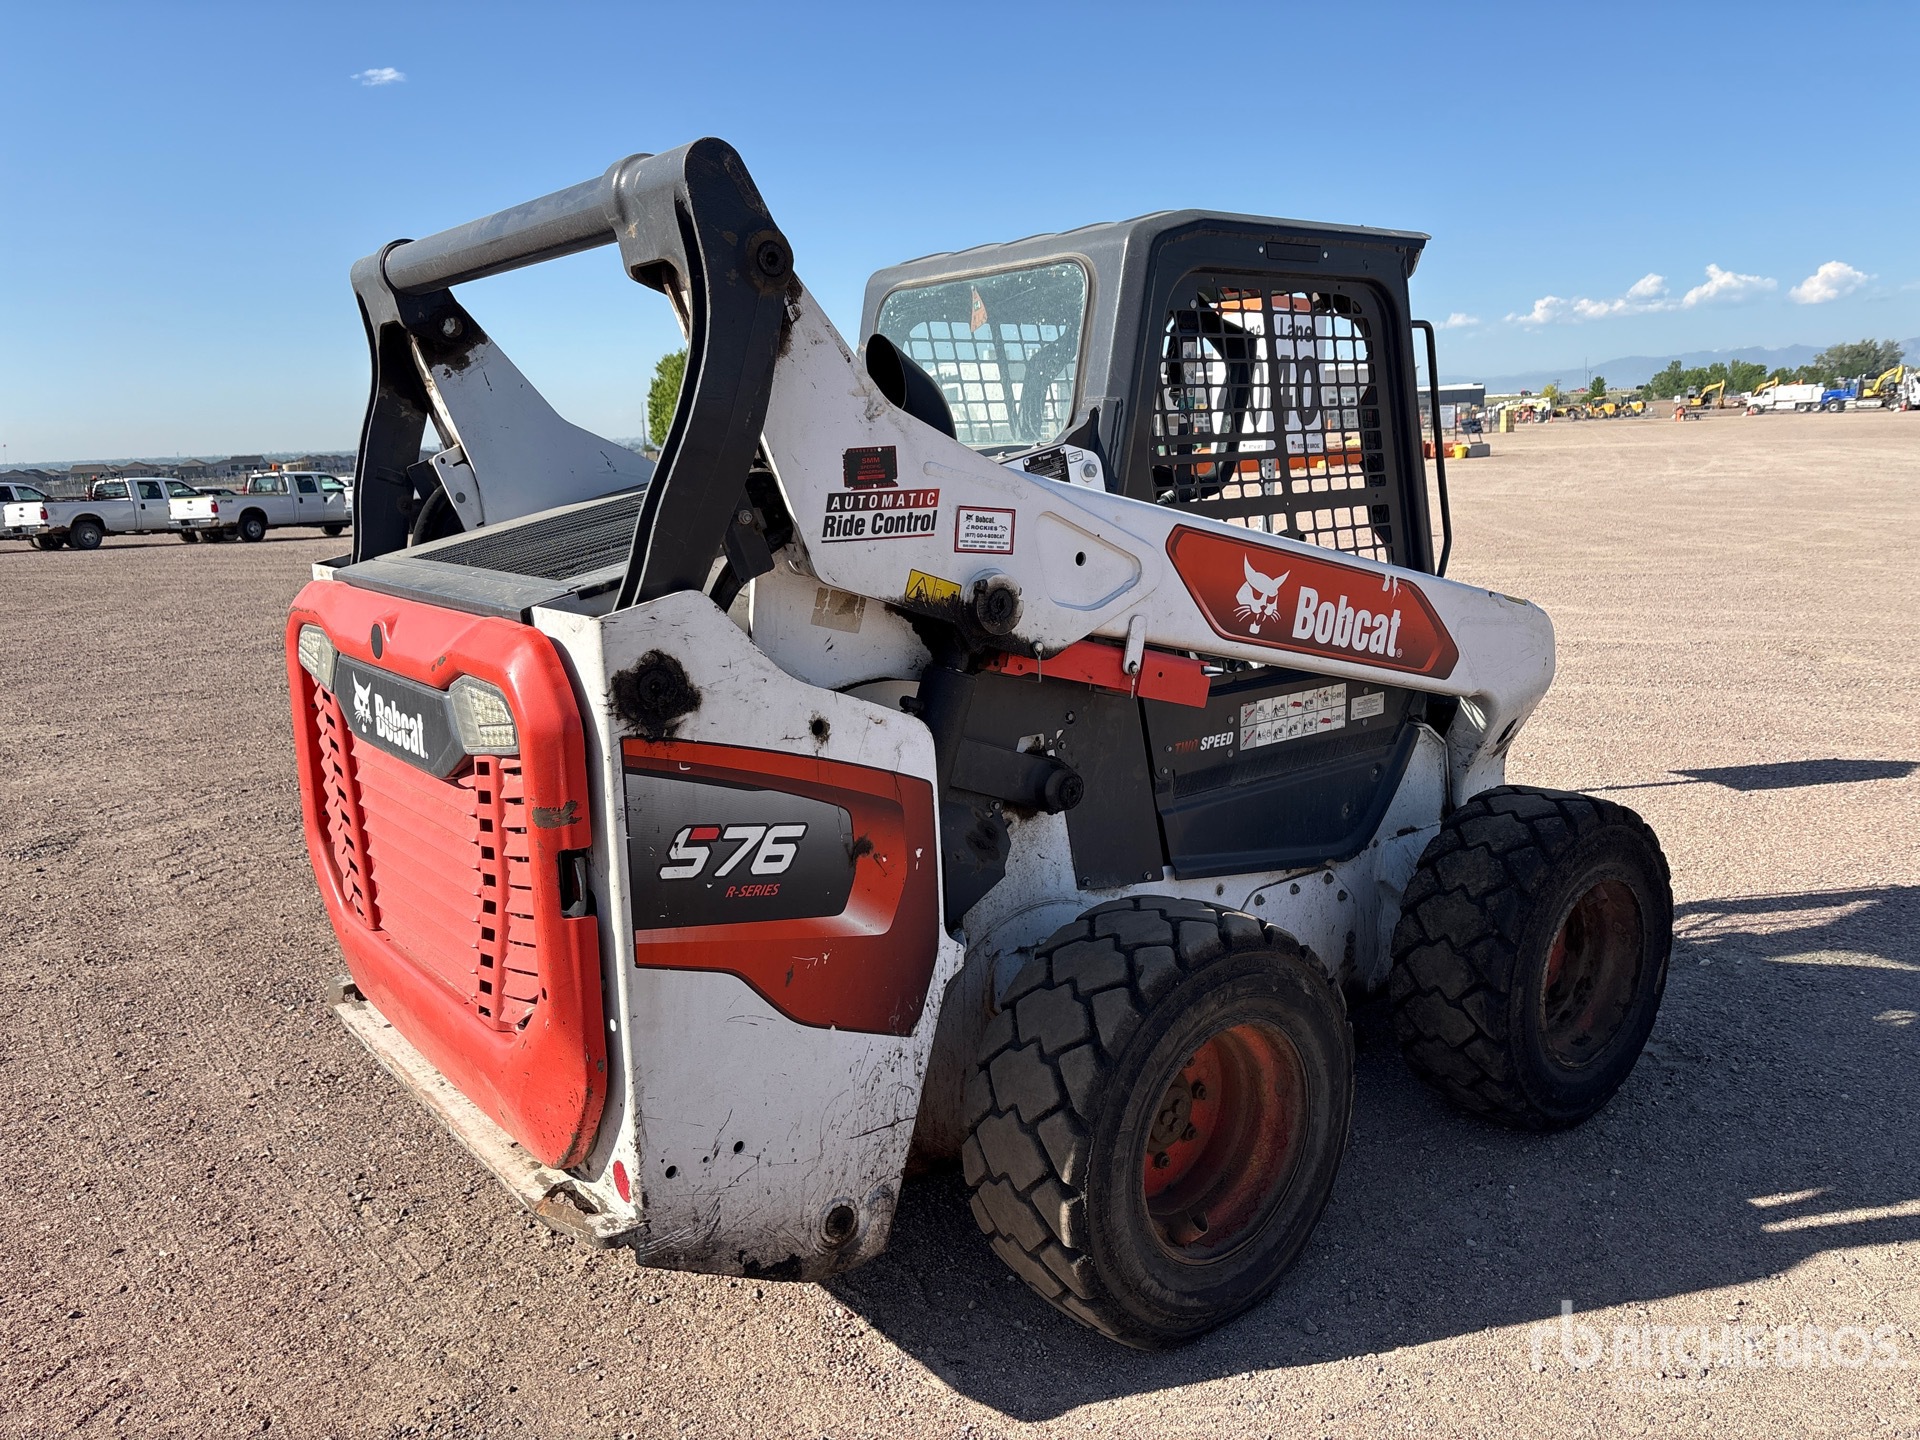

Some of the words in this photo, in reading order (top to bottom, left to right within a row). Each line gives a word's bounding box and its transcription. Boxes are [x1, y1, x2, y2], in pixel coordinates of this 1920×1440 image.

[1280, 317, 1313, 342] Lane
[831, 491, 936, 511] AUTOMATIC
[822, 514, 867, 538] Ride
[871, 509, 938, 534] Control
[1292, 585, 1402, 658] Bobcat
[374, 693, 426, 759] Bobcat
[1200, 731, 1234, 751] SPEED
[657, 822, 809, 881] S76
[725, 883, 780, 898] R-SERIES
